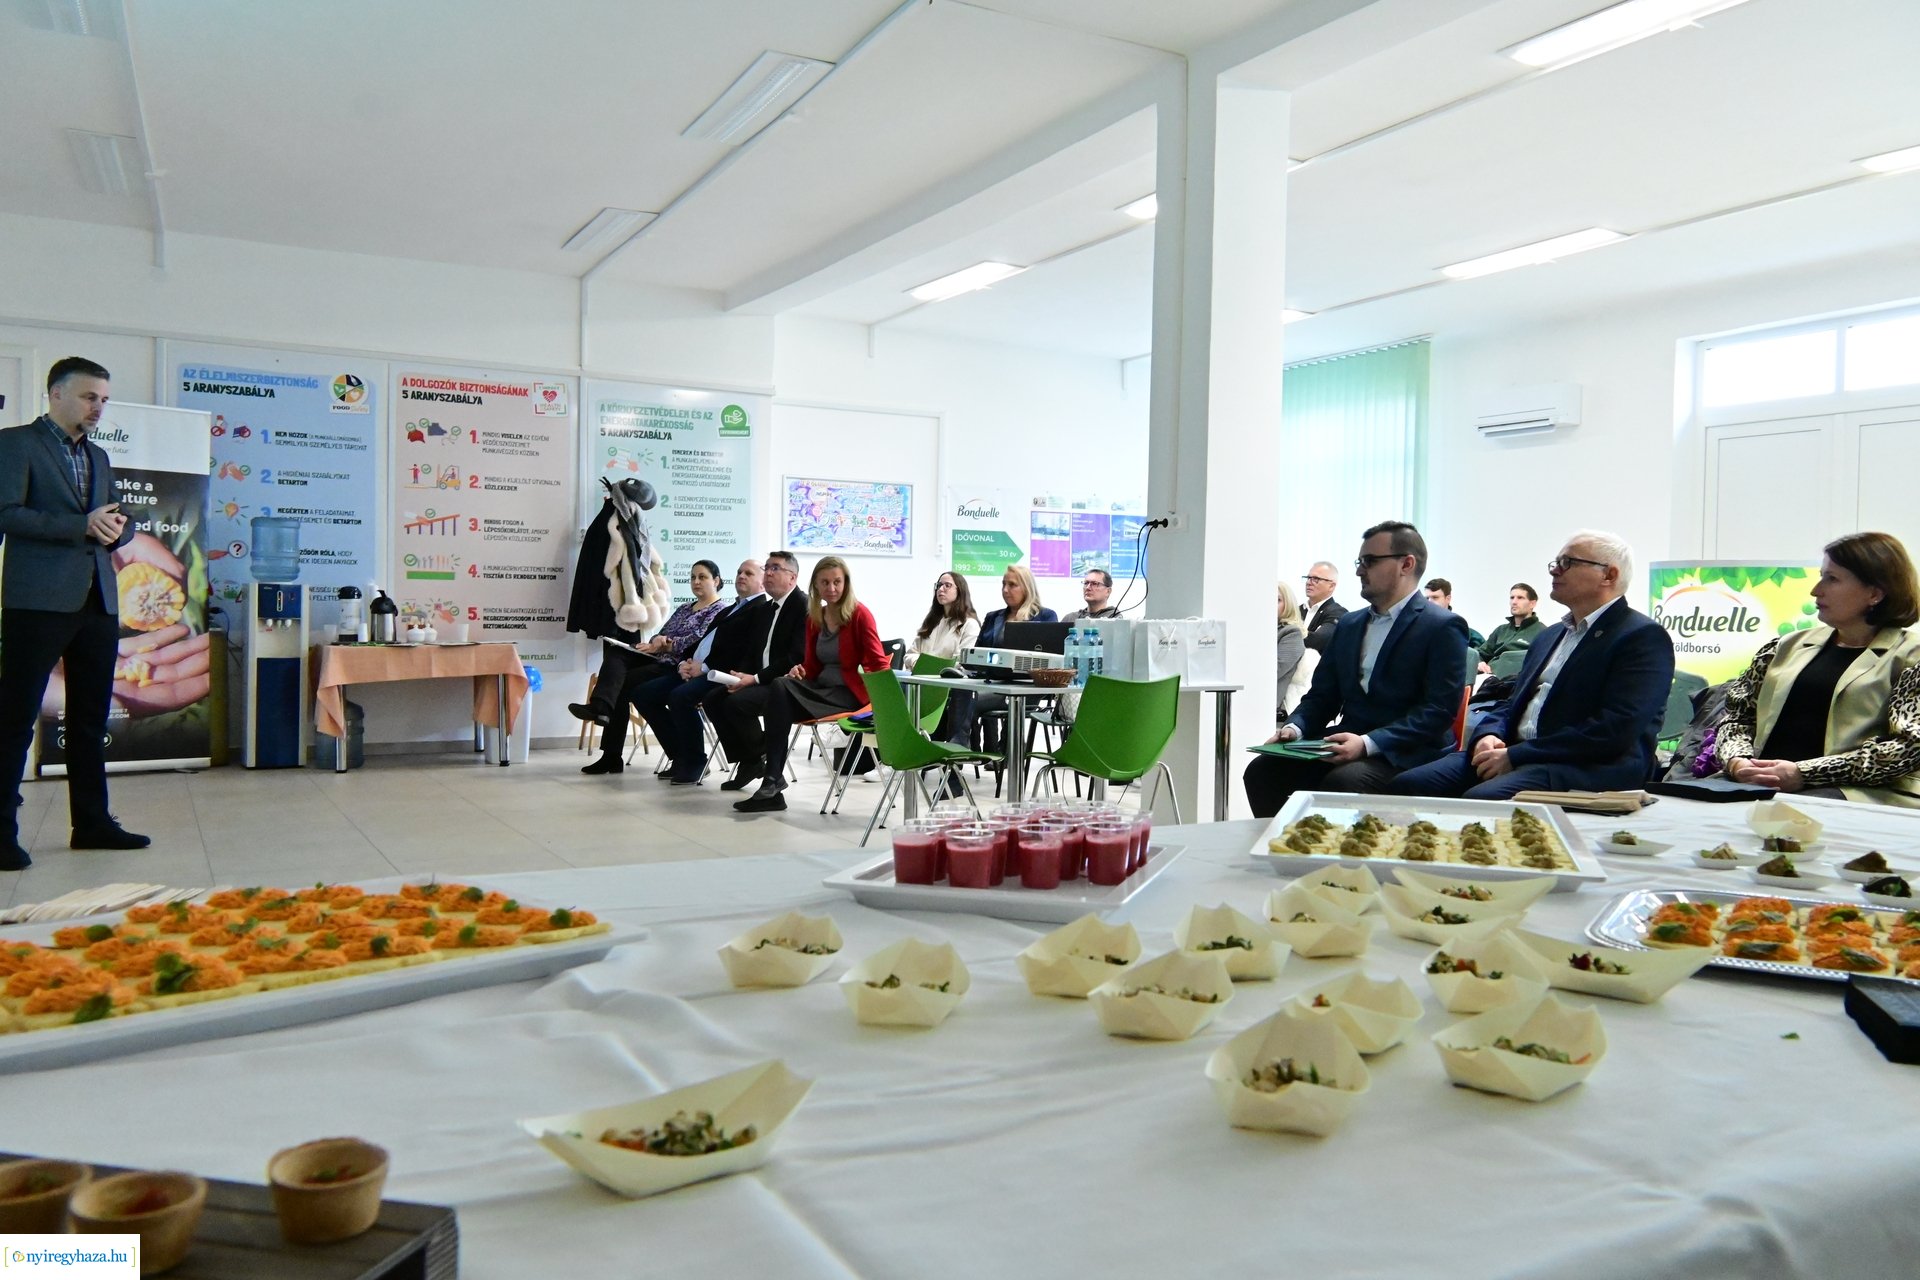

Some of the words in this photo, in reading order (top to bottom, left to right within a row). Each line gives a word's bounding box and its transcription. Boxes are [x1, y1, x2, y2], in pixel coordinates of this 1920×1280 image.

[183, 369, 196, 378] AZ
[200, 368, 319, 389] ÉLELMISZERBIZTONSÁG
[183, 382, 190, 391] 5
[193, 383, 275, 398] ARANYSZABÁLYA
[402, 378, 408, 386] A
[410, 378, 457, 390] DOLGOZÓK
[460, 383, 529, 397] BIZTONSÁGÁNAK
[402, 390, 408, 398] 5
[411, 391, 482, 405] ARANYSZABÁLYA
[600, 404, 605, 412] A
[607, 403, 690, 418] KÖRNYEZETVÉDELEM
[691, 409, 701, 418] ÉS
[703, 412, 712, 420] AZ
[89, 427, 129, 442] duelle
[260, 429, 271, 444] 1.
[469, 430, 480, 444] 1.
[600, 428, 606, 436] 5
[608, 428, 672, 440] ARANYSZABÁLYA
[661, 456, 669, 469] 1.
[260, 469, 274, 484] 2.
[469, 474, 481, 489] 2.
[115, 479, 141, 490] ake
[145, 483, 153, 491] a
[122, 493, 158, 505] ture
[661, 495, 671, 508] 2.
[957, 505, 1000, 520] Bonduelle
[135, 521, 151, 531] ed
[155, 520, 189, 533] food
[469, 518, 481, 531] 3.
[661, 529, 671, 542] 3.
[468, 564, 480, 578] 4.
[468, 607, 480, 620] 5.
[1654, 604, 1761, 638] Bonduelle
[1672, 642, 1721, 654] öldborsó
